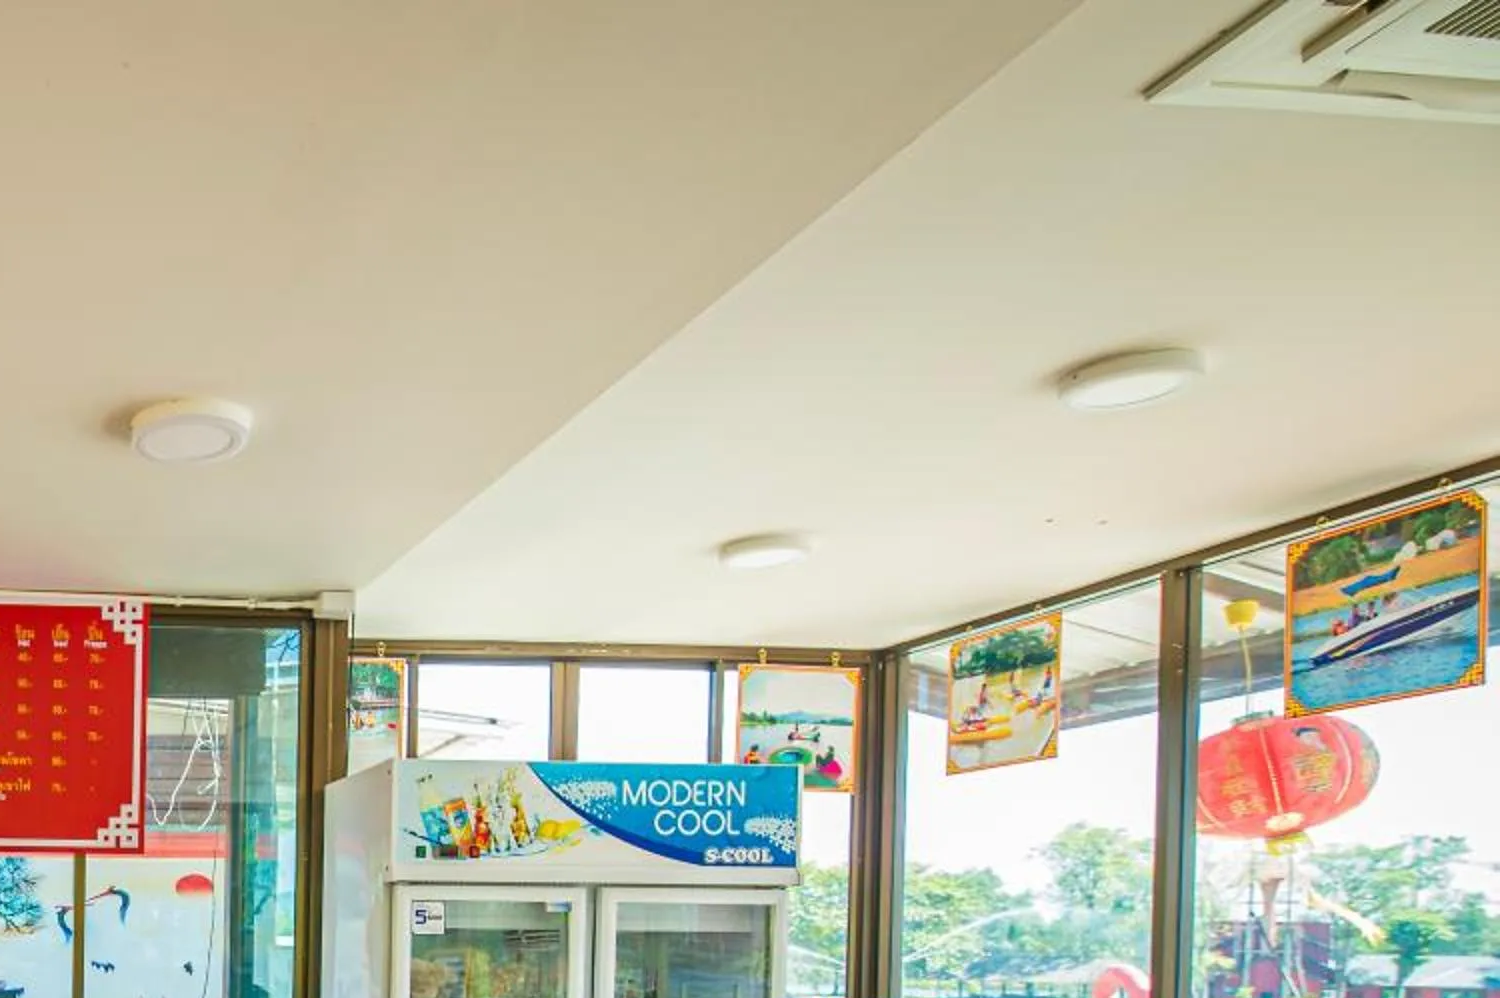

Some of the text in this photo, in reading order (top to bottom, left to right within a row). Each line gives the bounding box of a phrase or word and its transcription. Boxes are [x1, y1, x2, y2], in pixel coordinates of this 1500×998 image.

[622, 779, 747, 807] MODERN
[654, 809, 741, 836] COOL
[704, 847, 774, 864] S-COOL
